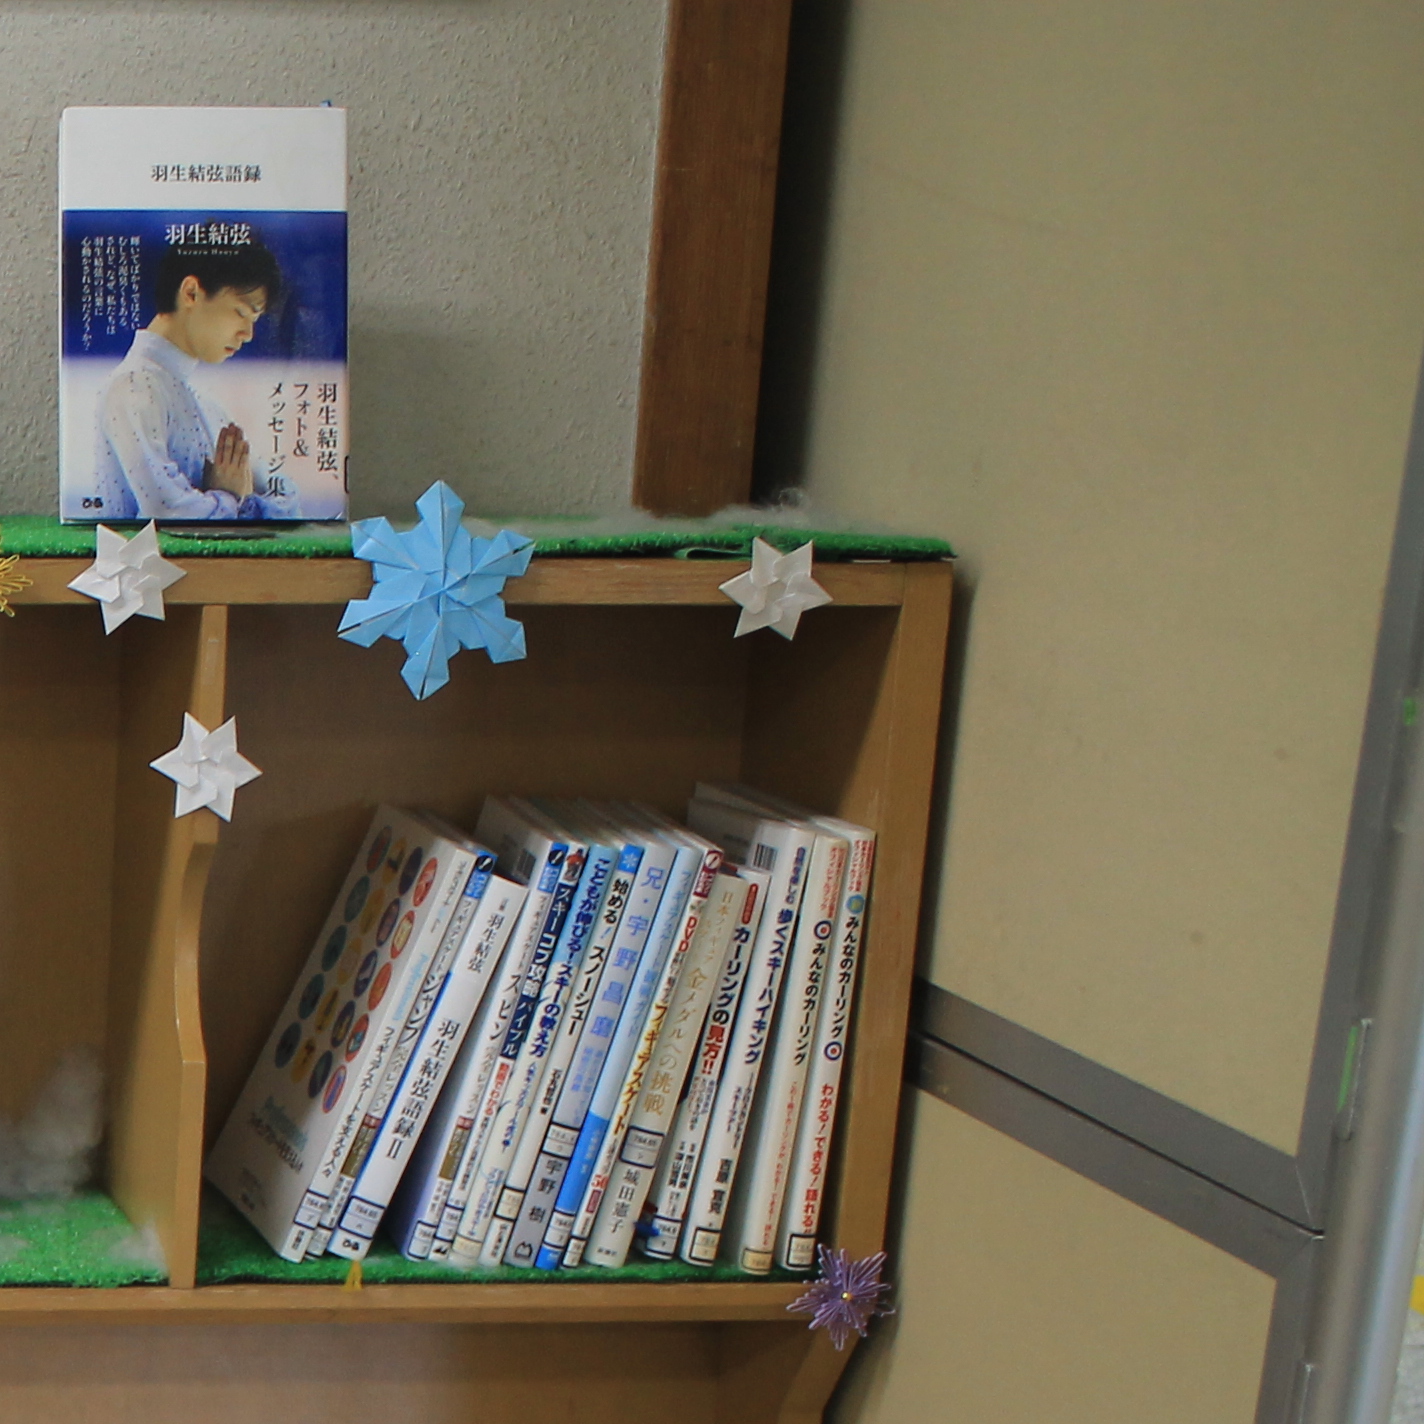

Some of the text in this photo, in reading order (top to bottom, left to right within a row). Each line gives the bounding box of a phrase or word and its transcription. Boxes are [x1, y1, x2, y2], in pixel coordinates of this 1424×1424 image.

[151, 164, 262, 182] 羽生結弦語録
[165, 222, 251, 246] 羽生結弦
[265, 383, 287, 497] メッセージ集
[317, 383, 340, 480] 羽生結弦、
[467, 913, 507, 975] 羽生結弦
[678, 916, 698, 953] DVD
[830, 916, 860, 1039] みんなのカーリング
[488, 973, 522, 1043] スピン
[567, 944, 606, 1036] スノーシュー
[701, 926, 752, 1075] カーリングの見方!!
[745, 909, 794, 1064] 歩くスキーハイキング
[793, 943, 827, 1066] みんなのカーリング
[642, 967, 708, 1116] 金メダルへの挑戦
[609, 1168, 641, 1234] 城田憲子
